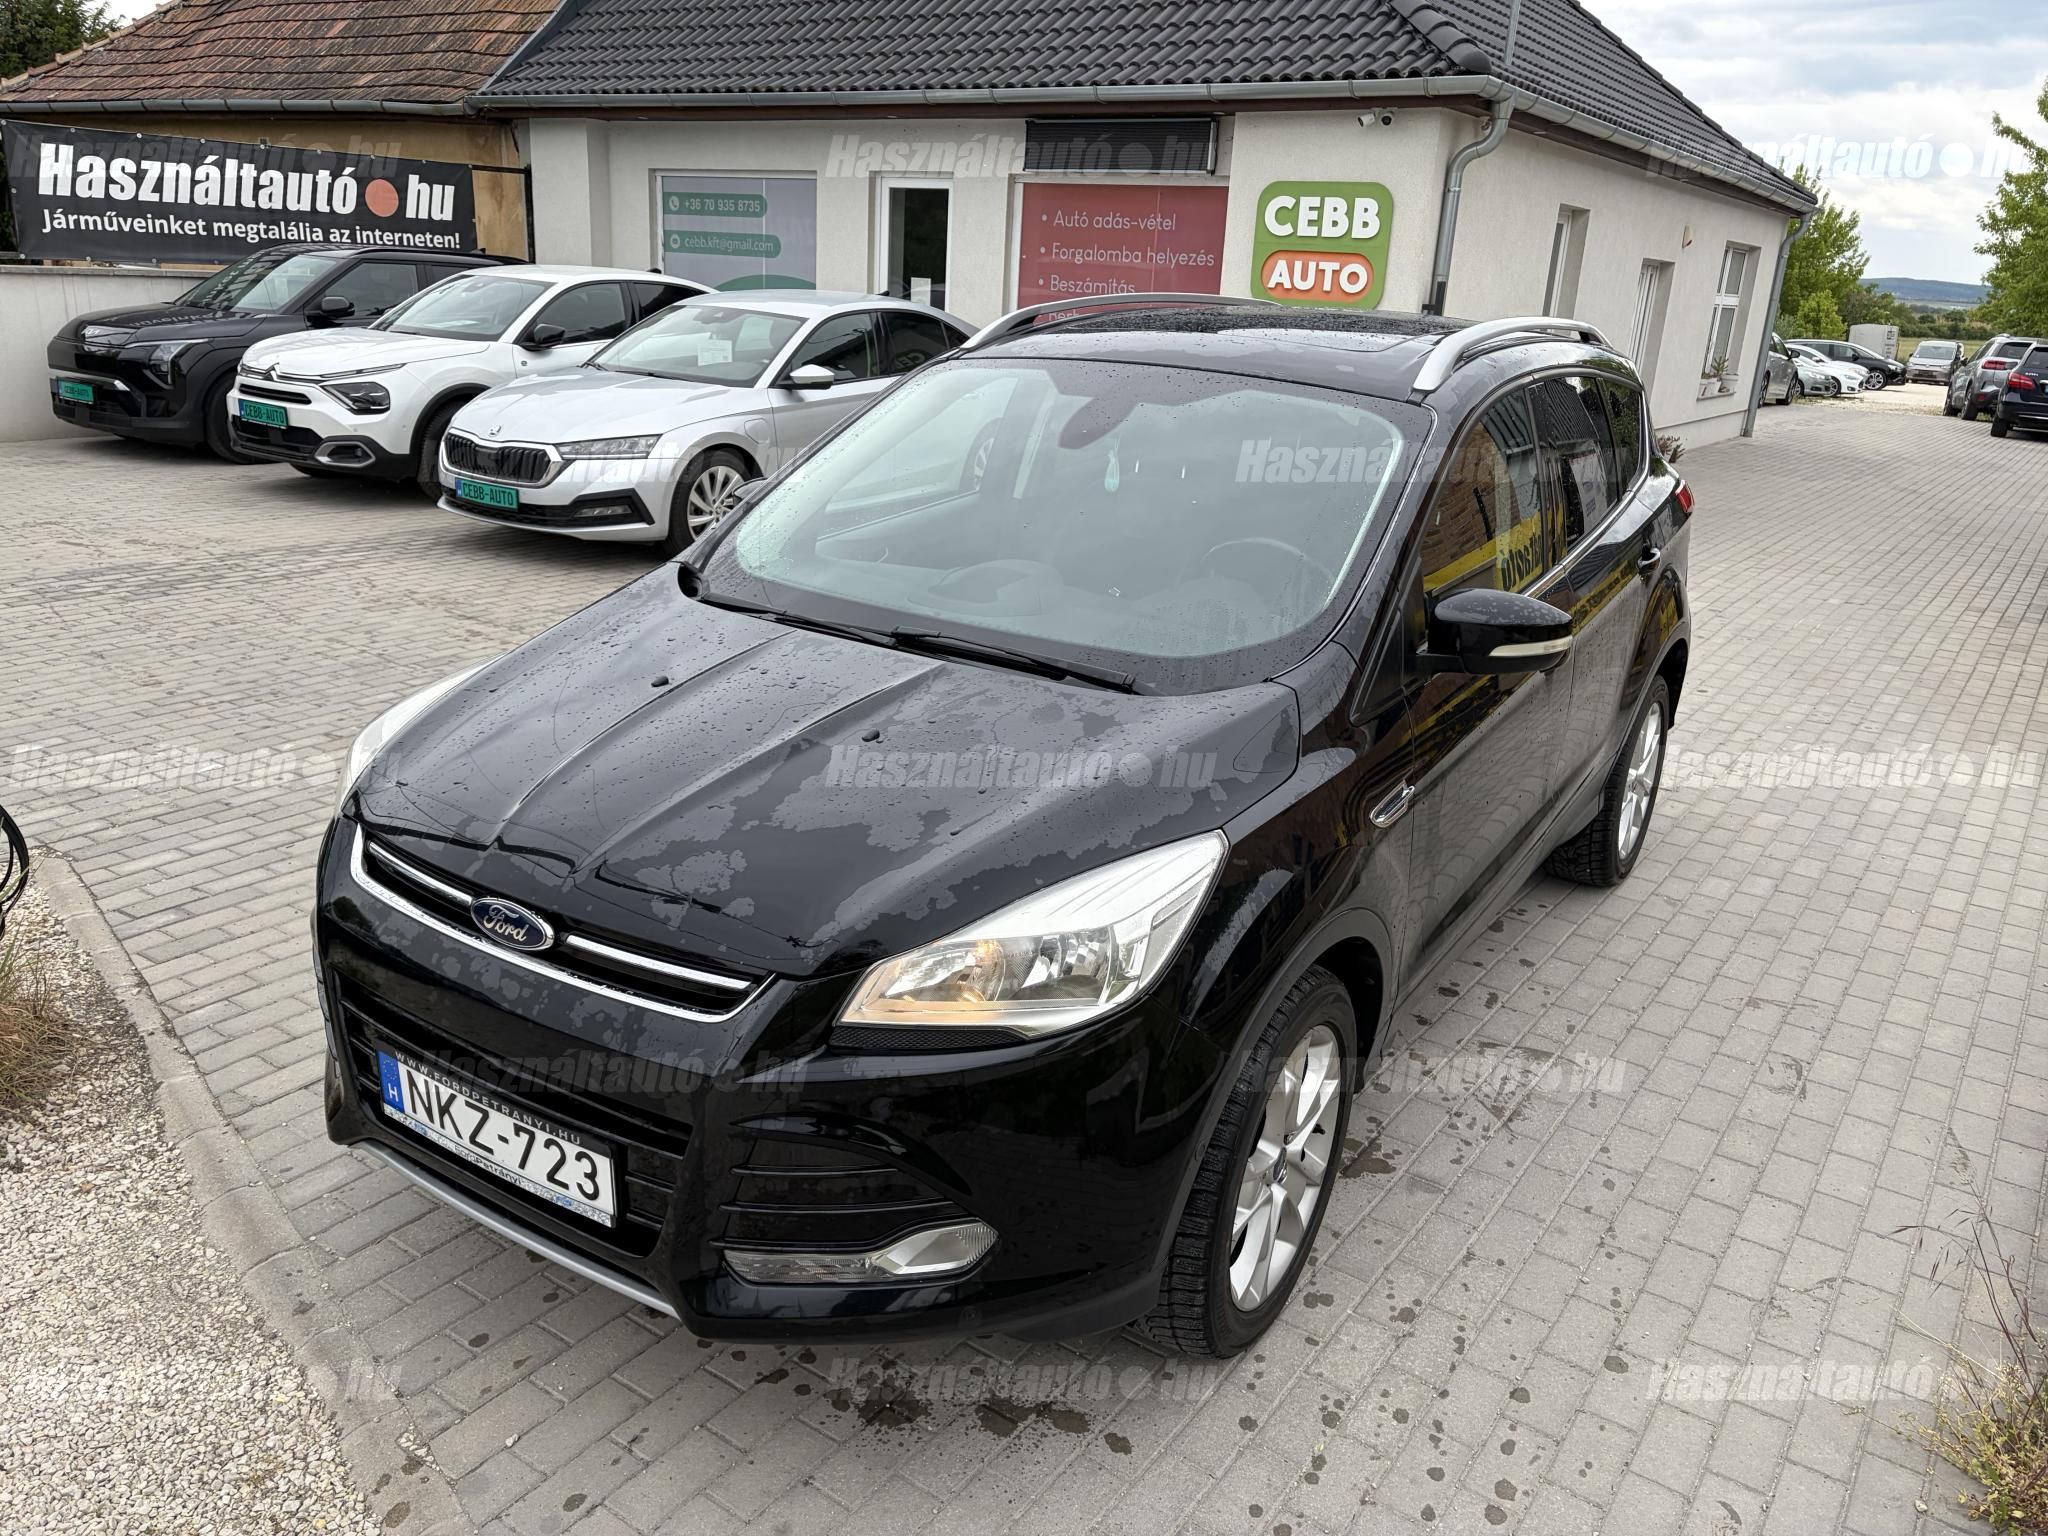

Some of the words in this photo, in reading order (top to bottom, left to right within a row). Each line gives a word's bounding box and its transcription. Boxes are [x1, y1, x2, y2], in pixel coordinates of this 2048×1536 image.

[684, 198, 702, 210] +36
[704, 199, 715, 210] 70
[718, 199, 735, 211] 935
[737, 200, 761, 212] 8735
[1264, 195, 1381, 239] CEBB
[42, 208, 207, 236] Járműveinket
[329, 228, 351, 243] az
[356, 225, 461, 248] interneten!
[1053, 209, 1089, 228] Autó
[1093, 211, 1176, 230] adás-vétel
[1052, 243, 1142, 264] Forgalomba
[1146, 246, 1215, 269] helyezés
[1050, 274, 1135, 294] Beszámítás
[1267, 259, 1368, 294] AUTO
[244, 403, 285, 424] CEBB-AUTO
[463, 483, 513, 505] CEBB-AUTO
[483, 904, 529, 942] Ford
[388, 1083, 399, 1103] H
[395, 1051, 581, 1145] WWW.FORDPETRANYI.HU
[405, 1069, 600, 1201] NKZ-723
